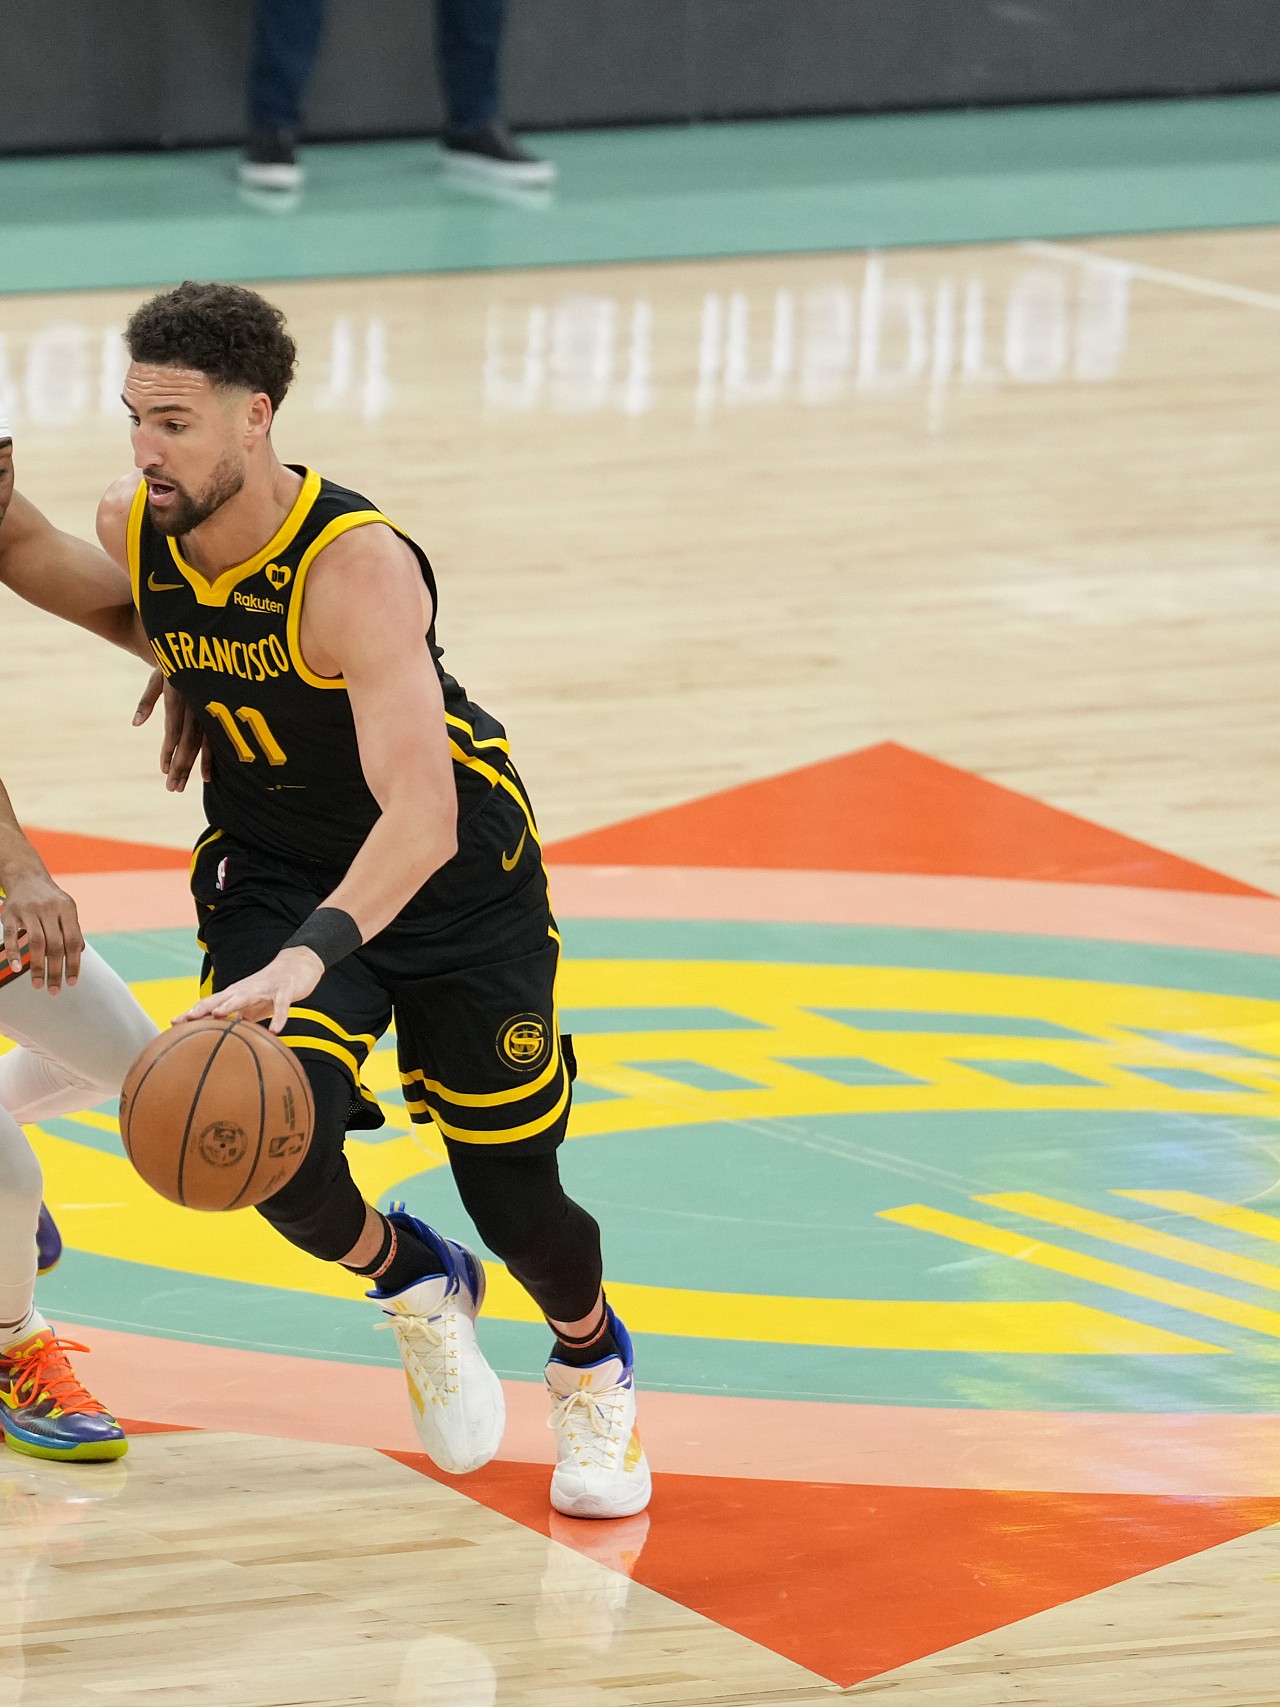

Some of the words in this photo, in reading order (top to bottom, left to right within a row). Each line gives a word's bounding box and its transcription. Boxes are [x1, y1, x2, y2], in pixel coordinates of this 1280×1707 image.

[271, 569, 285, 584] DM
[233, 591, 284, 615] Rakuten
[165, 631, 289, 682] FRANCISCO
[205, 700, 287, 766] 11
[578, 1373, 593, 1387] 11
